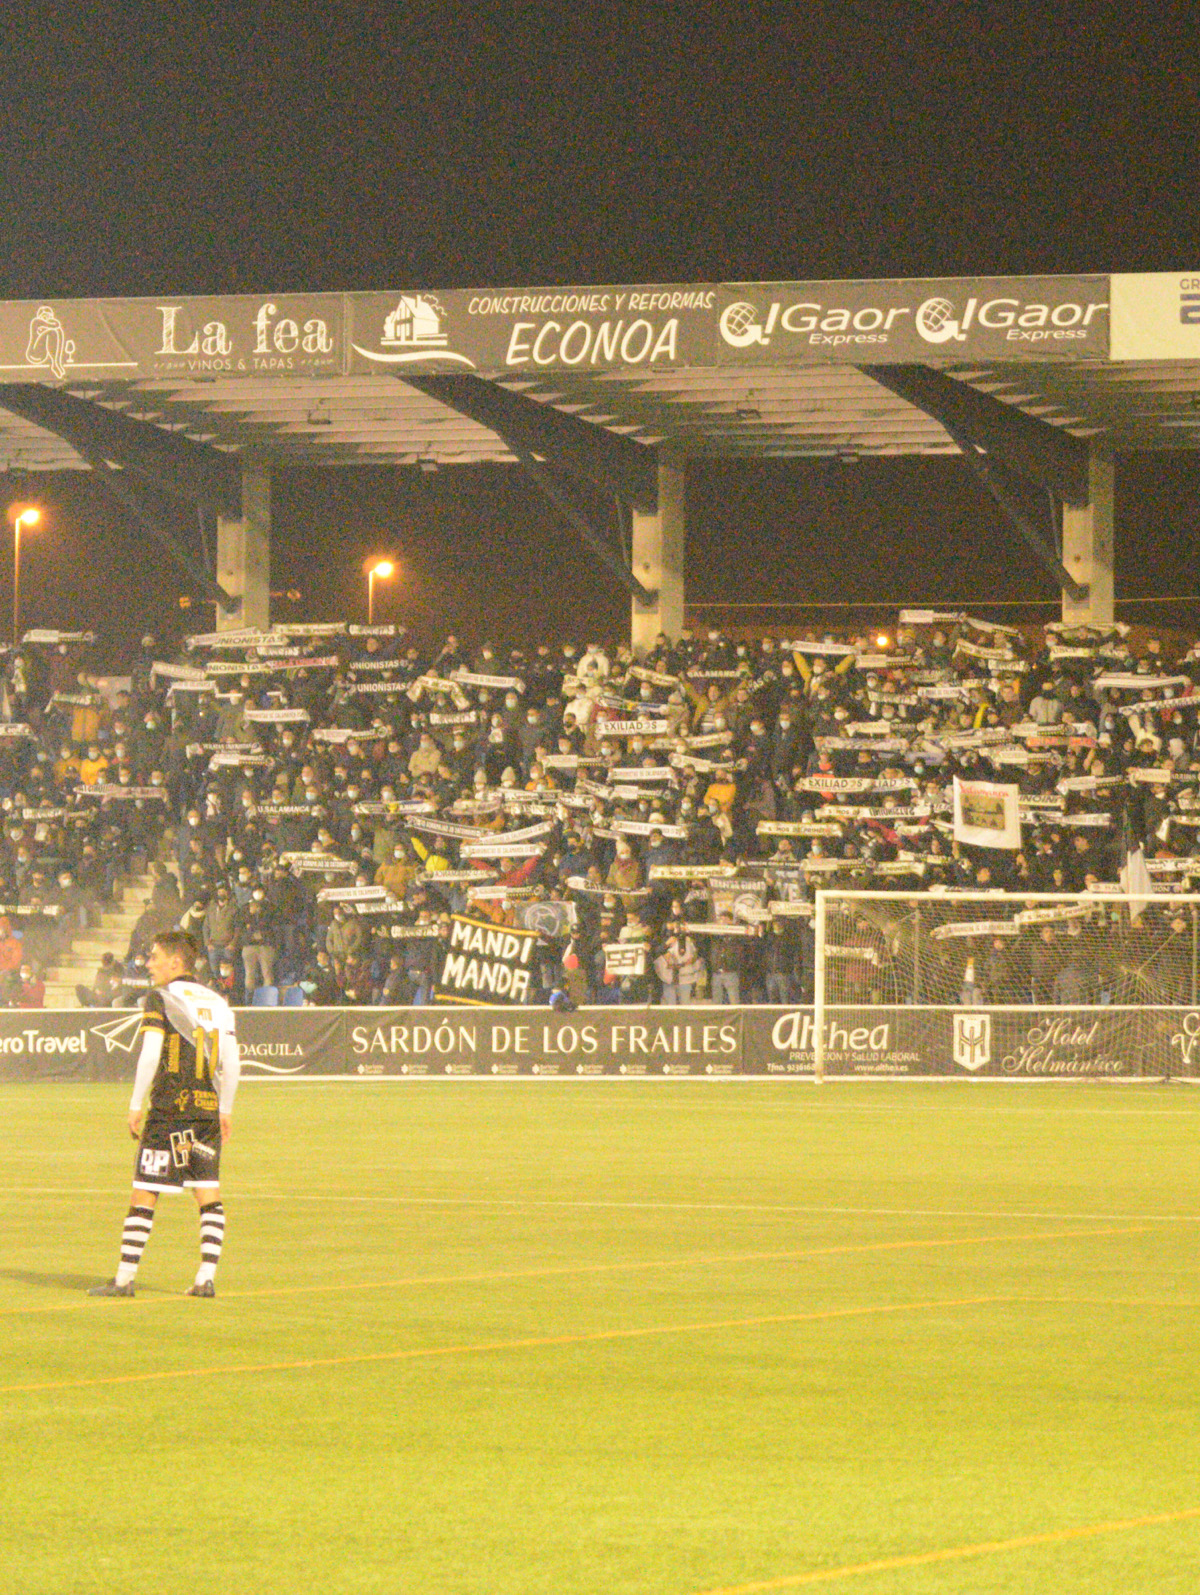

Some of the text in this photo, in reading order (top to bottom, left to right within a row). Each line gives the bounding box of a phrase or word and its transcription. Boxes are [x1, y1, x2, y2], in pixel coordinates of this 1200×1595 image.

[468, 291, 716, 315] CONSTRUCCIONES Y REFORMAS
[154, 302, 333, 356] La fea
[504, 317, 681, 366] ECONOA
[808, 332, 889, 346] Express
[1005, 327, 1088, 343] Express
[188, 357, 294, 371] VINOS & TAPAS
[0, 1029, 88, 1055] roTravel
[351, 1017, 737, 1054] SARDÓN DE LOS FRAILES
[1027, 1016, 1099, 1046] Hotel
